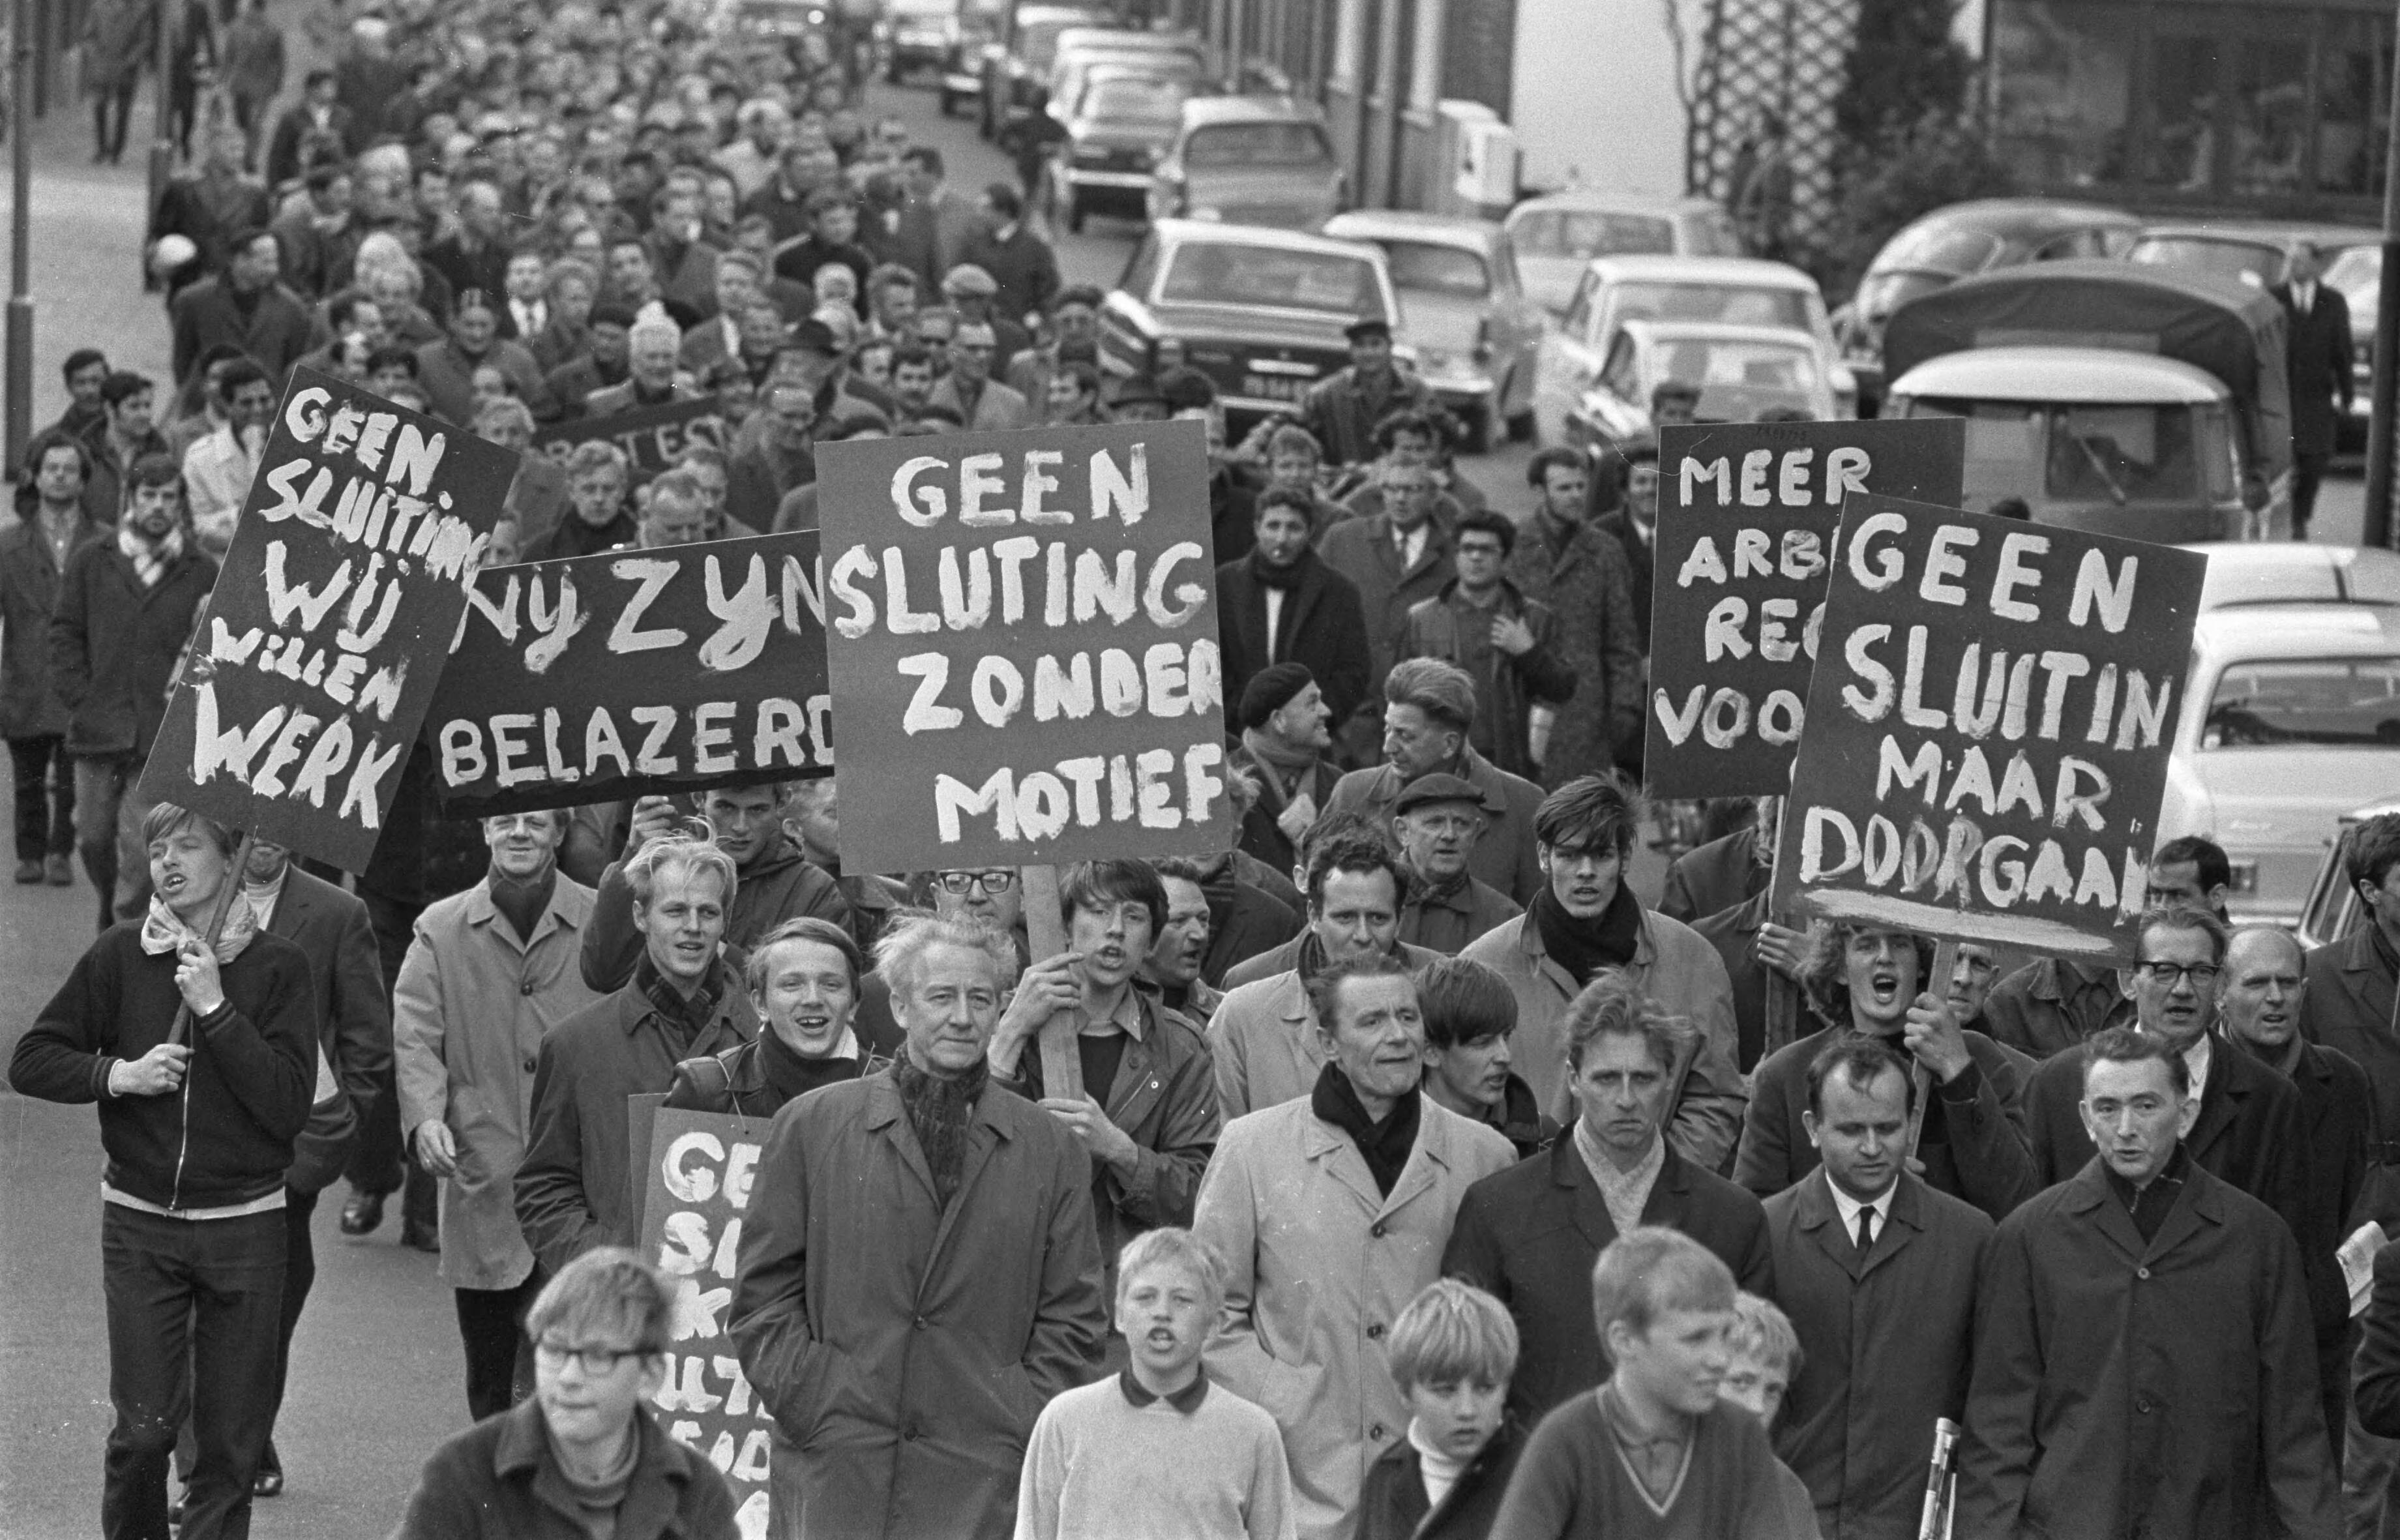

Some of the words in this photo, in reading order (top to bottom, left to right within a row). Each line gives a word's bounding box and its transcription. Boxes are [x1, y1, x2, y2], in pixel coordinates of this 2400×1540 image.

[285, 387, 446, 496] GEEN
[891, 442, 1149, 527] GEEN
[1680, 447, 1872, 507] MEER
[829, 536, 1207, 639] SLUTING
[1848, 512, 2139, 633] GEEN
[897, 638, 1223, 736] ZONDER
[1842, 623, 2172, 751] SLUITIN
[193, 682, 402, 828] WERK
[935, 742, 1223, 844] MOTIEF
[1876, 734, 2112, 832] MAAR
